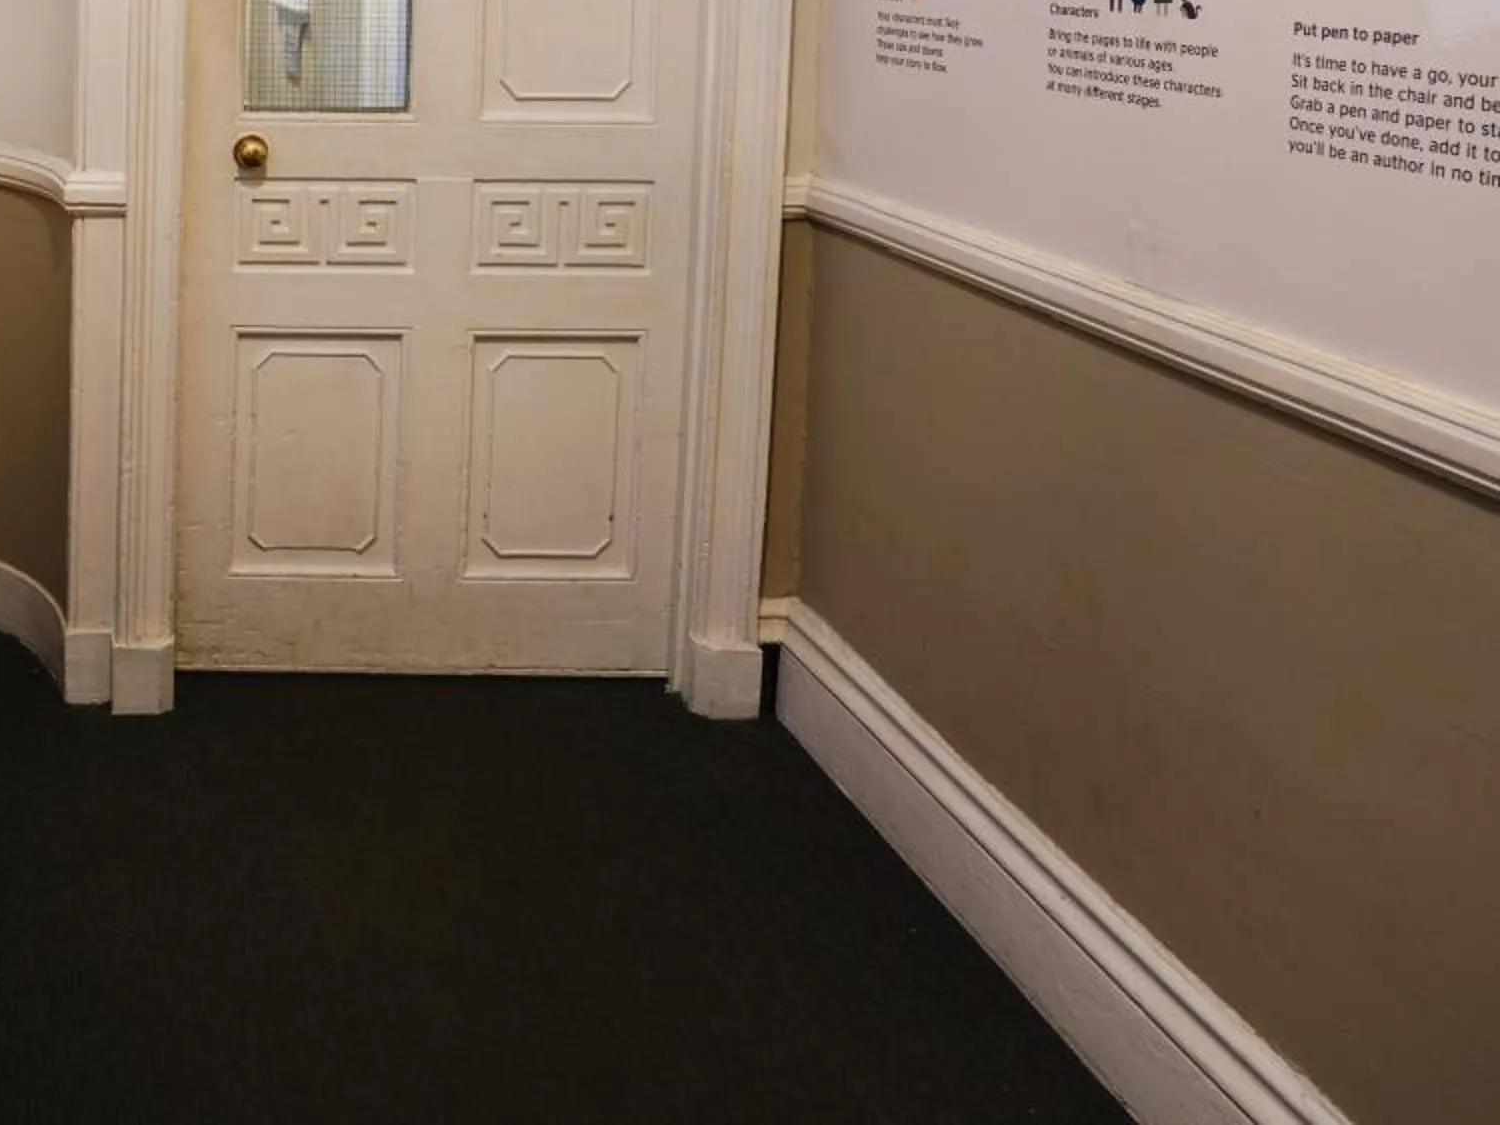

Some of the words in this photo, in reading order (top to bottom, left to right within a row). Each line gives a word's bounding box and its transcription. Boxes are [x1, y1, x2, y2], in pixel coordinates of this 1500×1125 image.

[1050, 2, 1098, 19] Characters
[1048, 28, 1072, 43] Bring
[1074, 31, 1089, 44] the
[1092, 34, 1120, 48] pages
[1123, 37, 1133, 48] to
[1135, 36, 1150, 50] life
[1154, 40, 1176, 53] with
[1180, 43, 1218, 59] people
[1293, 21, 1317, 37] Put
[1321, 26, 1349, 40] pen
[1353, 27, 1369, 42] to
[1373, 29, 1420, 47] paper
[1059, 47, 1094, 62] animals
[1096, 51, 1106, 63] of
[1109, 54, 1145, 68] various
[1293, 52, 1311, 68] It's
[1315, 54, 1347, 72] time
[1351, 59, 1367, 74] to
[1371, 60, 1407, 77] have
[1413, 68, 1422, 80] a
[1458, 72, 1499, 89] your
[1046, 80, 1055, 90] at
[1057, 82, 1082, 96] many
[1084, 85, 1124, 101] different
[1047, 62, 1063, 75] You
[1066, 67, 1083, 77] can
[1084, 68, 1130, 84] introduce
[1133, 75, 1160, 90] these
[1163, 79, 1221, 98] characters
[1291, 74, 1308, 89] Sit
[1312, 76, 1345, 94] back
[1350, 82, 1363, 96] in
[1368, 83, 1393, 100] the
[1397, 87, 1438, 104] chair
[1443, 94, 1475, 110] and
[1290, 94, 1322, 113] Grab
[1327, 103, 1335, 114] a
[1339, 103, 1367, 119] pen
[1371, 108, 1400, 124] and
[1405, 113, 1452, 131] paper
[1458, 118, 1475, 134] to
[1289, 116, 1324, 134] Once
[1329, 124, 1376, 144] you've
[1381, 131, 1423, 152] done,
[1429, 139, 1460, 156] add
[1466, 142, 1478, 159] it
[1484, 147, 1500, 163] to
[1288, 139, 1324, 156] you'll
[1329, 144, 1346, 160] be
[1351, 150, 1369, 164] an
[1373, 154, 1424, 174] author
[1430, 160, 1445, 178] in
[1451, 167, 1473, 182] no
